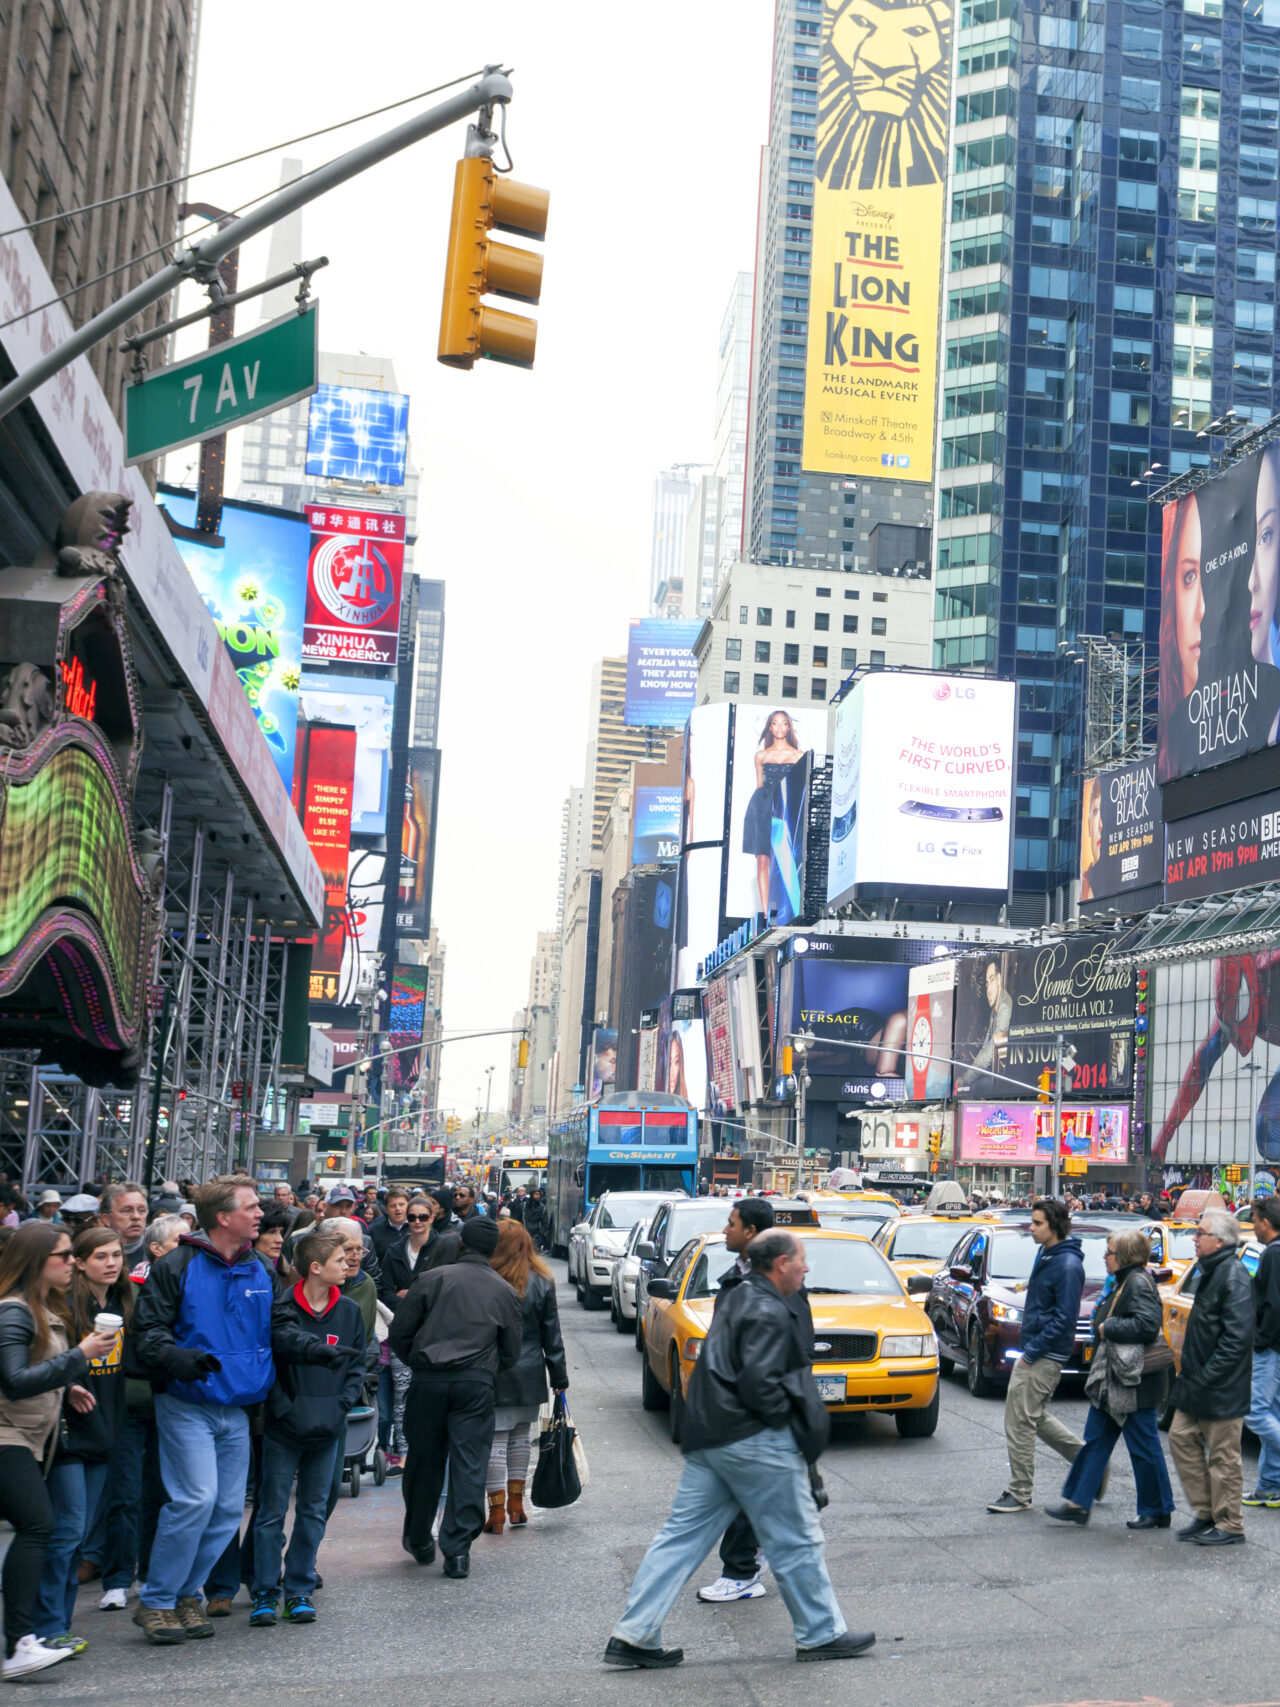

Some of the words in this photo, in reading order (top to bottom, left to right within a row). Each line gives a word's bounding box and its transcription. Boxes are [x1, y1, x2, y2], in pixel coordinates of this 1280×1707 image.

[845, 231, 899, 261] THE
[823, 372, 846, 384] THE
[850, 376, 919, 391] LANDMARK
[184, 373, 203, 424] 7
[822, 385, 876, 399] MUSICAL
[880, 390, 919, 403] EVENT
[835, 412, 878, 427] Minskoff
[881, 417, 918, 431] Theatre
[823, 425, 876, 442] Broadway
[879, 430, 887, 441] &
[891, 432, 914, 444] 45th
[824, 449, 878, 463] lionking.com
[311, 511, 396, 534] 新华通讯社
[1219, 551, 1228, 566] OF
[1228, 550, 1233, 562] A
[335, 602, 385, 622] XINHUA
[315, 632, 377, 650] XINHUA
[301, 644, 338, 657] NEWS
[340, 648, 390, 662] AGENCY
[637, 658, 676, 667] MATILDA
[642, 669, 665, 677] THEY
[666, 670, 688, 678] JUST
[640, 680, 669, 689] KNOW
[670, 681, 693, 689] HOW
[955, 687, 976, 700] LG
[1188, 664, 1258, 724] ORPHAN
[1198, 702, 1249, 756] BLACK
[911, 736, 936, 753] THE
[940, 743, 1001, 757] WORLD'S
[899, 749, 941, 771] FIRST
[340, 786, 347, 795] IS
[899, 782, 940, 796] FLEXIBLE
[943, 789, 1008, 799] SMARTPHONE
[1110, 763, 1156, 803] ORPHAN
[315, 795, 344, 805] SIMPLY
[1117, 791, 1149, 825] BLACK
[308, 806, 349, 816] NOTHING
[318, 817, 337, 826] ELSE
[313, 828, 328, 836] LIKE
[1108, 830, 1123, 844] NEW
[1126, 820, 1154, 838] SEASON
[1167, 835, 1194, 861] NEW
[1202, 818, 1259, 849] SEASON
[917, 842, 935, 853] LG
[1108, 844, 1118, 856] SAT
[1119, 840, 1129, 853] APR
[1121, 855, 1139, 873] BBC
[1167, 859, 1185, 884] SAT
[1186, 854, 1208, 878] APR
[1211, 849, 1234, 873] 19TH
[1237, 844, 1258, 867] 9PM
[1121, 870, 1138, 883] AMERICA
[1018, 943, 1073, 1006] Romeo
[1070, 938, 1131, 999] Santos
[800, 1012, 860, 1024] VERSACE
[1042, 1002, 1087, 1020] FORMULA
[1090, 1000, 1107, 1016] VOL
[1108, 999, 1114, 1014] 2
[1010, 1044, 1023, 1065] IN
[664, 1152, 677, 1160] NY
[774, 1212, 792, 1223] E25
